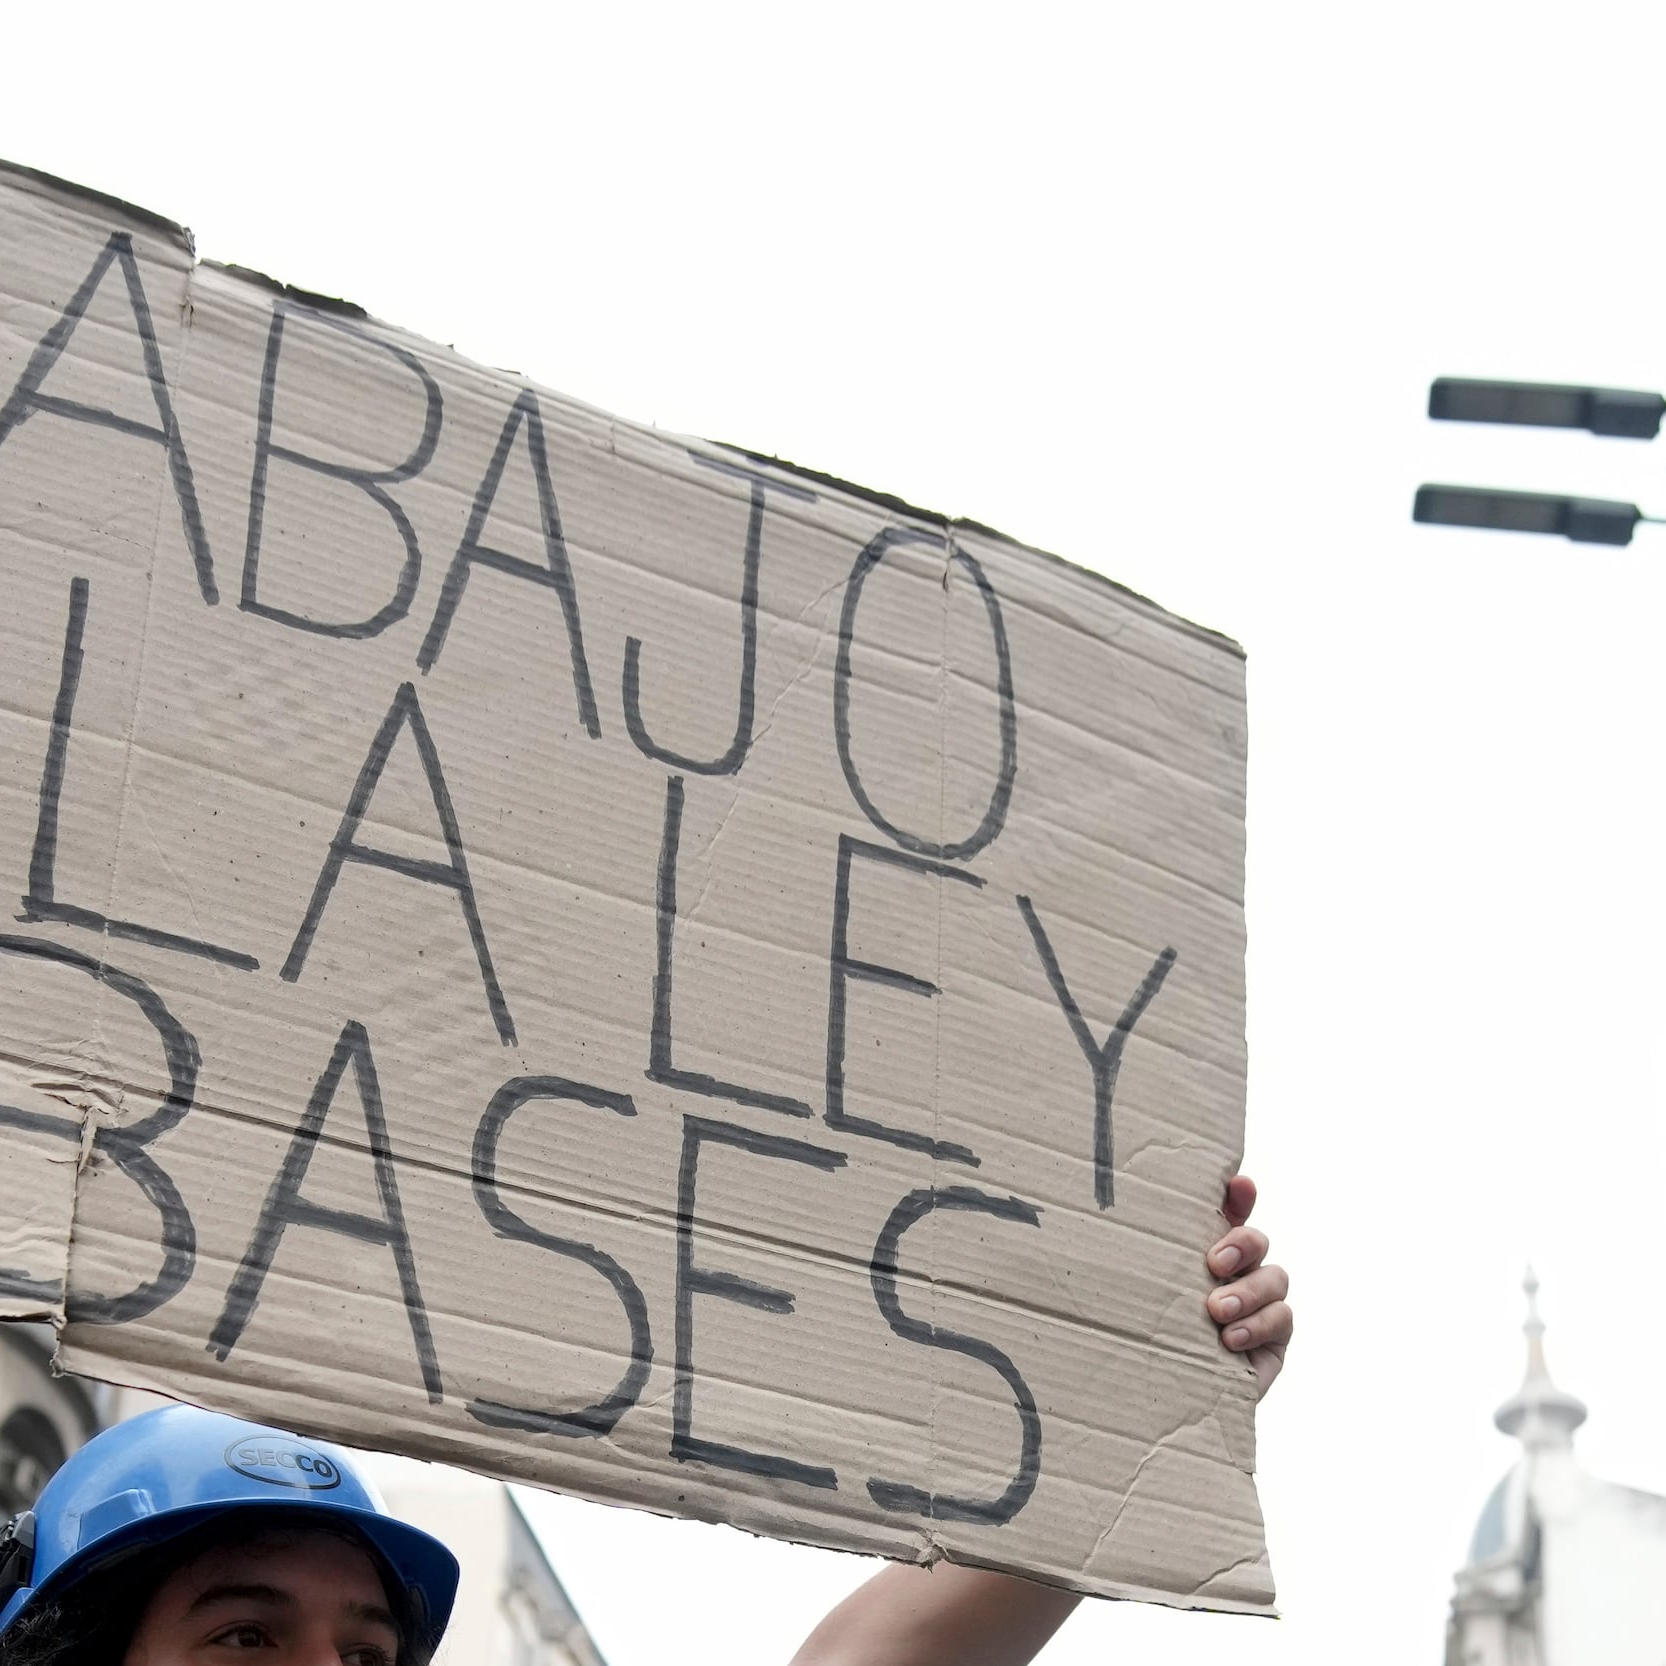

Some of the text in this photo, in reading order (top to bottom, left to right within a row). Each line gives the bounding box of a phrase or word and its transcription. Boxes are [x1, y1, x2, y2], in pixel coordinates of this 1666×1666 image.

[16, 578, 1179, 1210] LA LEY
[237, 1447, 333, 1479] SECCO
